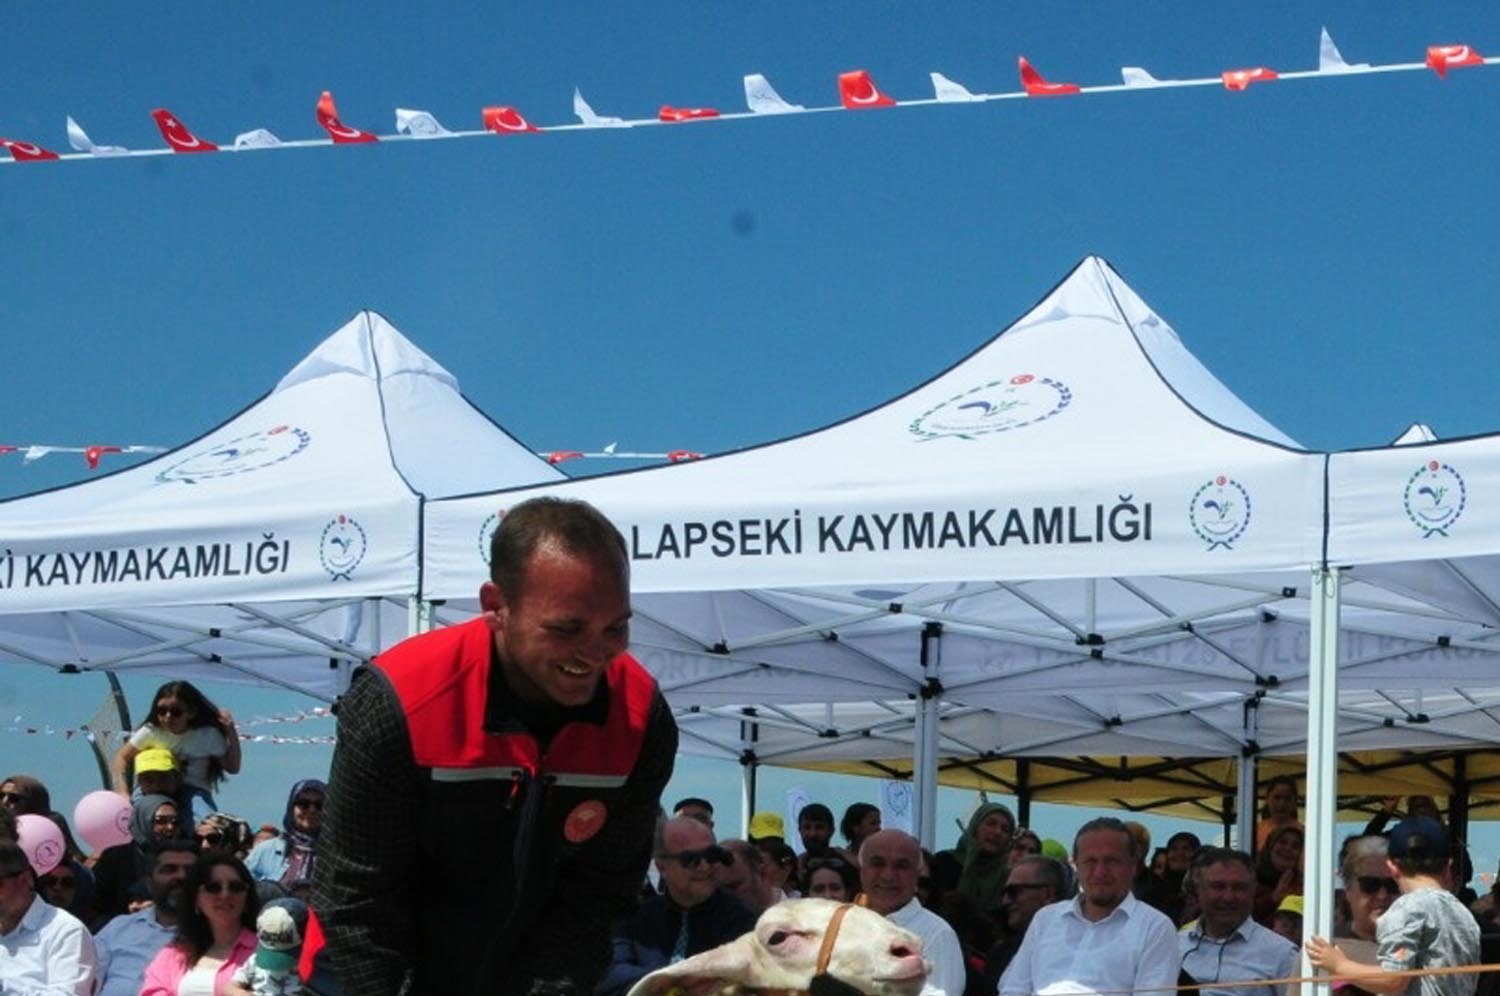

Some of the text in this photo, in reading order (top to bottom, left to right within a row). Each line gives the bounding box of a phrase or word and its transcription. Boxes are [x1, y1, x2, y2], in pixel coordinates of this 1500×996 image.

[631, 494, 1154, 561] LAPSEKİ KAYMAKAMLIĞI
[25, 532, 290, 588] KAYMAKAMLIĞI
